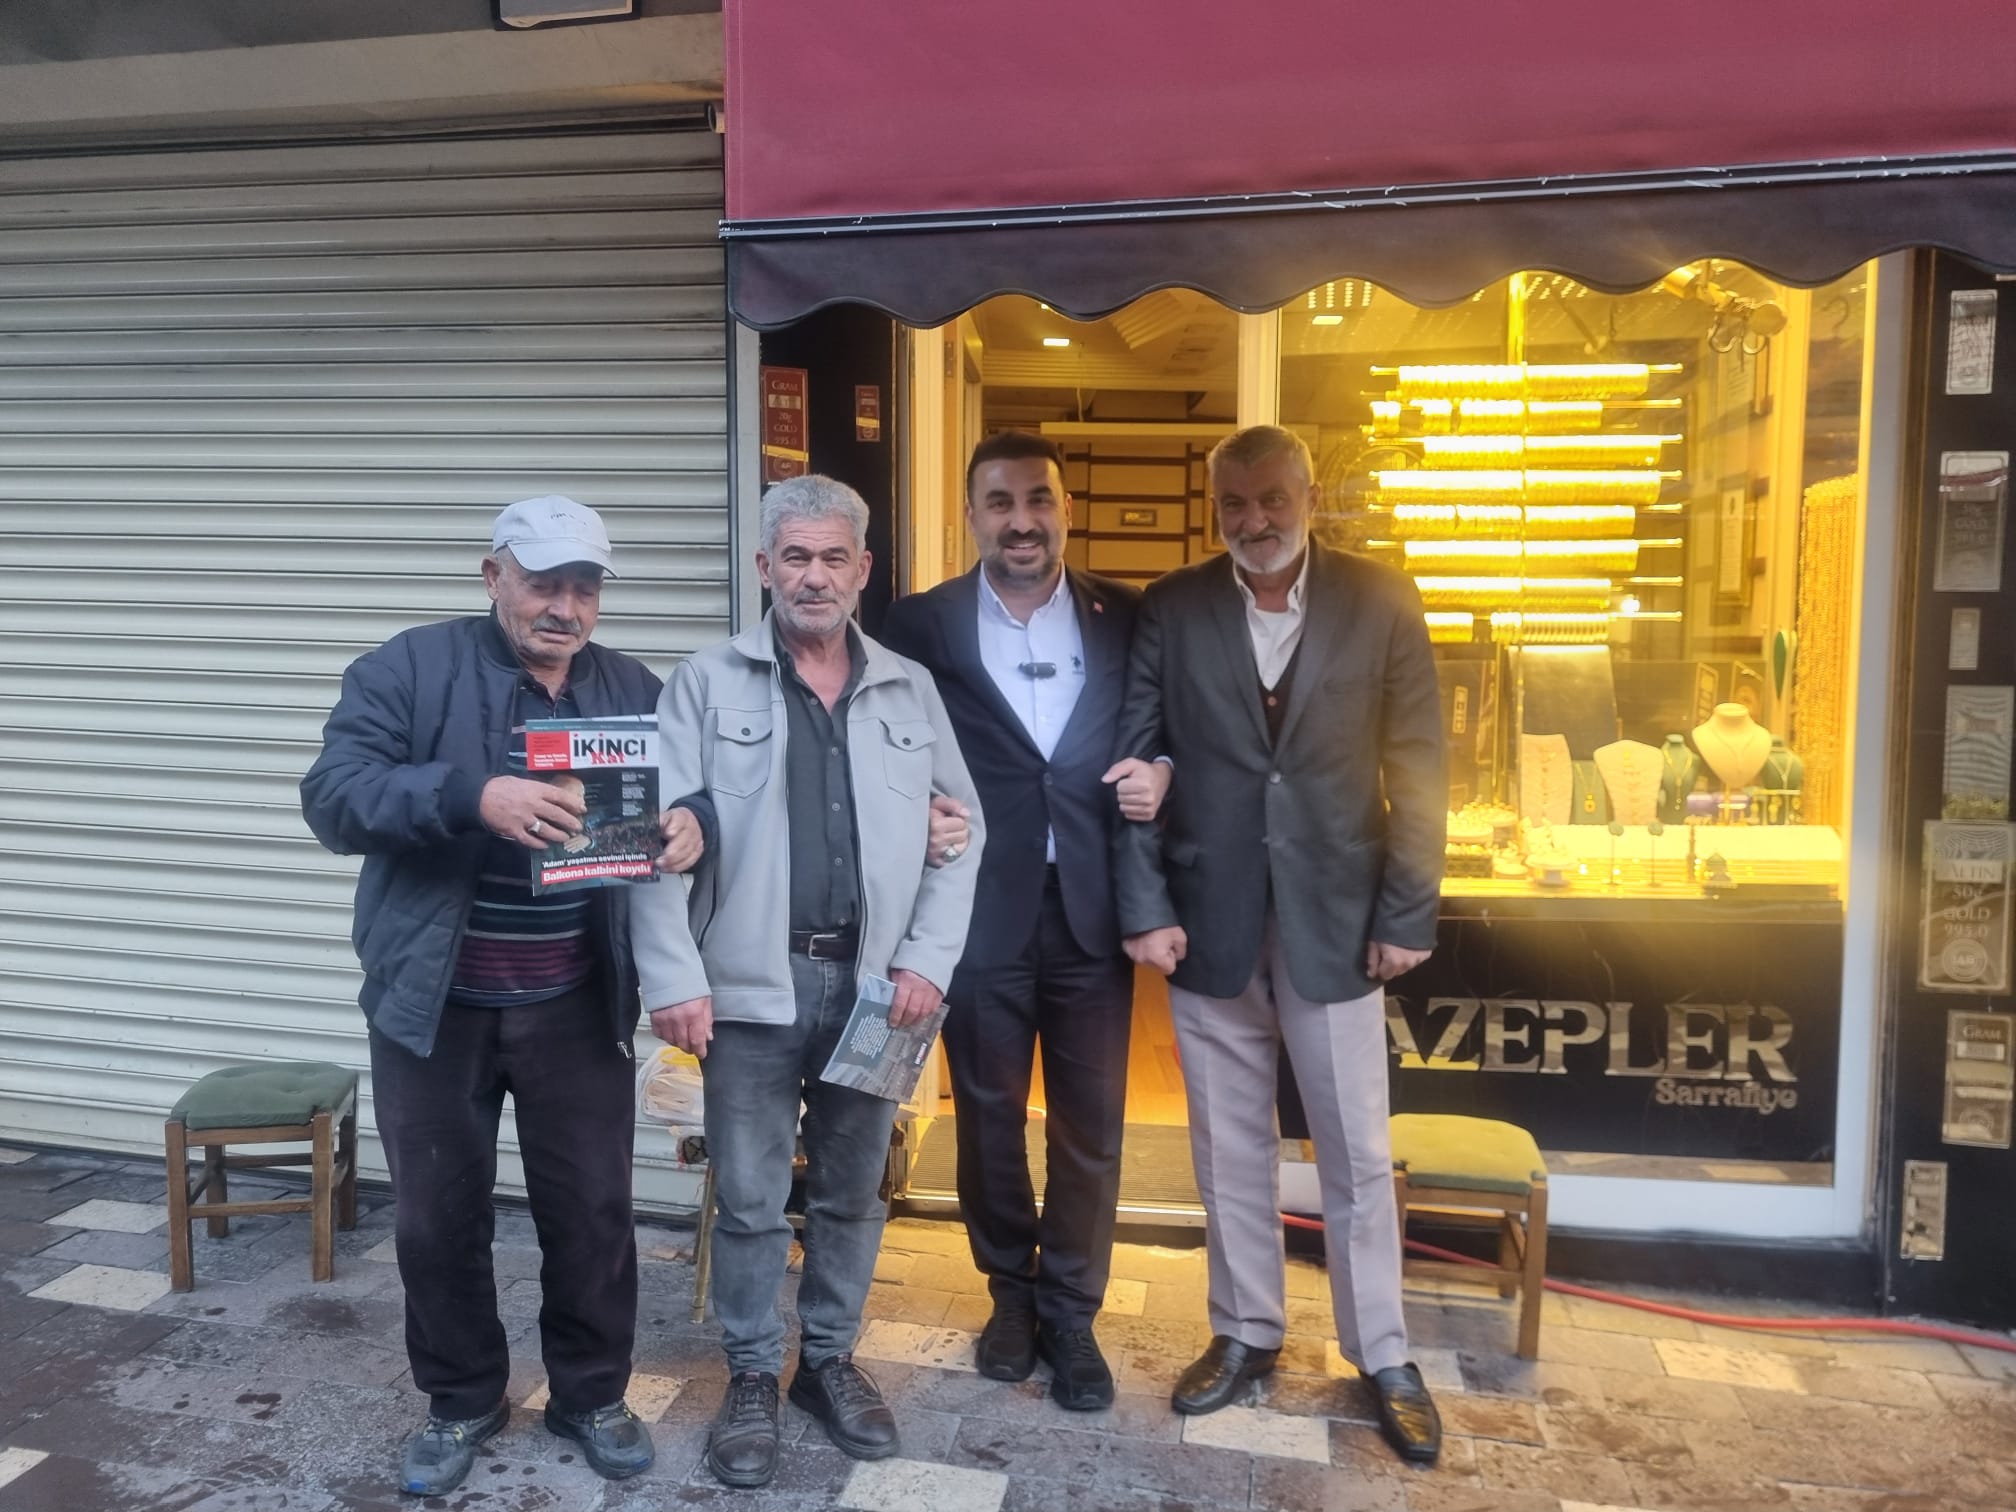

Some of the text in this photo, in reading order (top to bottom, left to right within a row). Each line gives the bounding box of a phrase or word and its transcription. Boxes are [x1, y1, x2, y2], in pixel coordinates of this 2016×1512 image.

[543, 863, 652, 882] Balkona kalbini koydu
